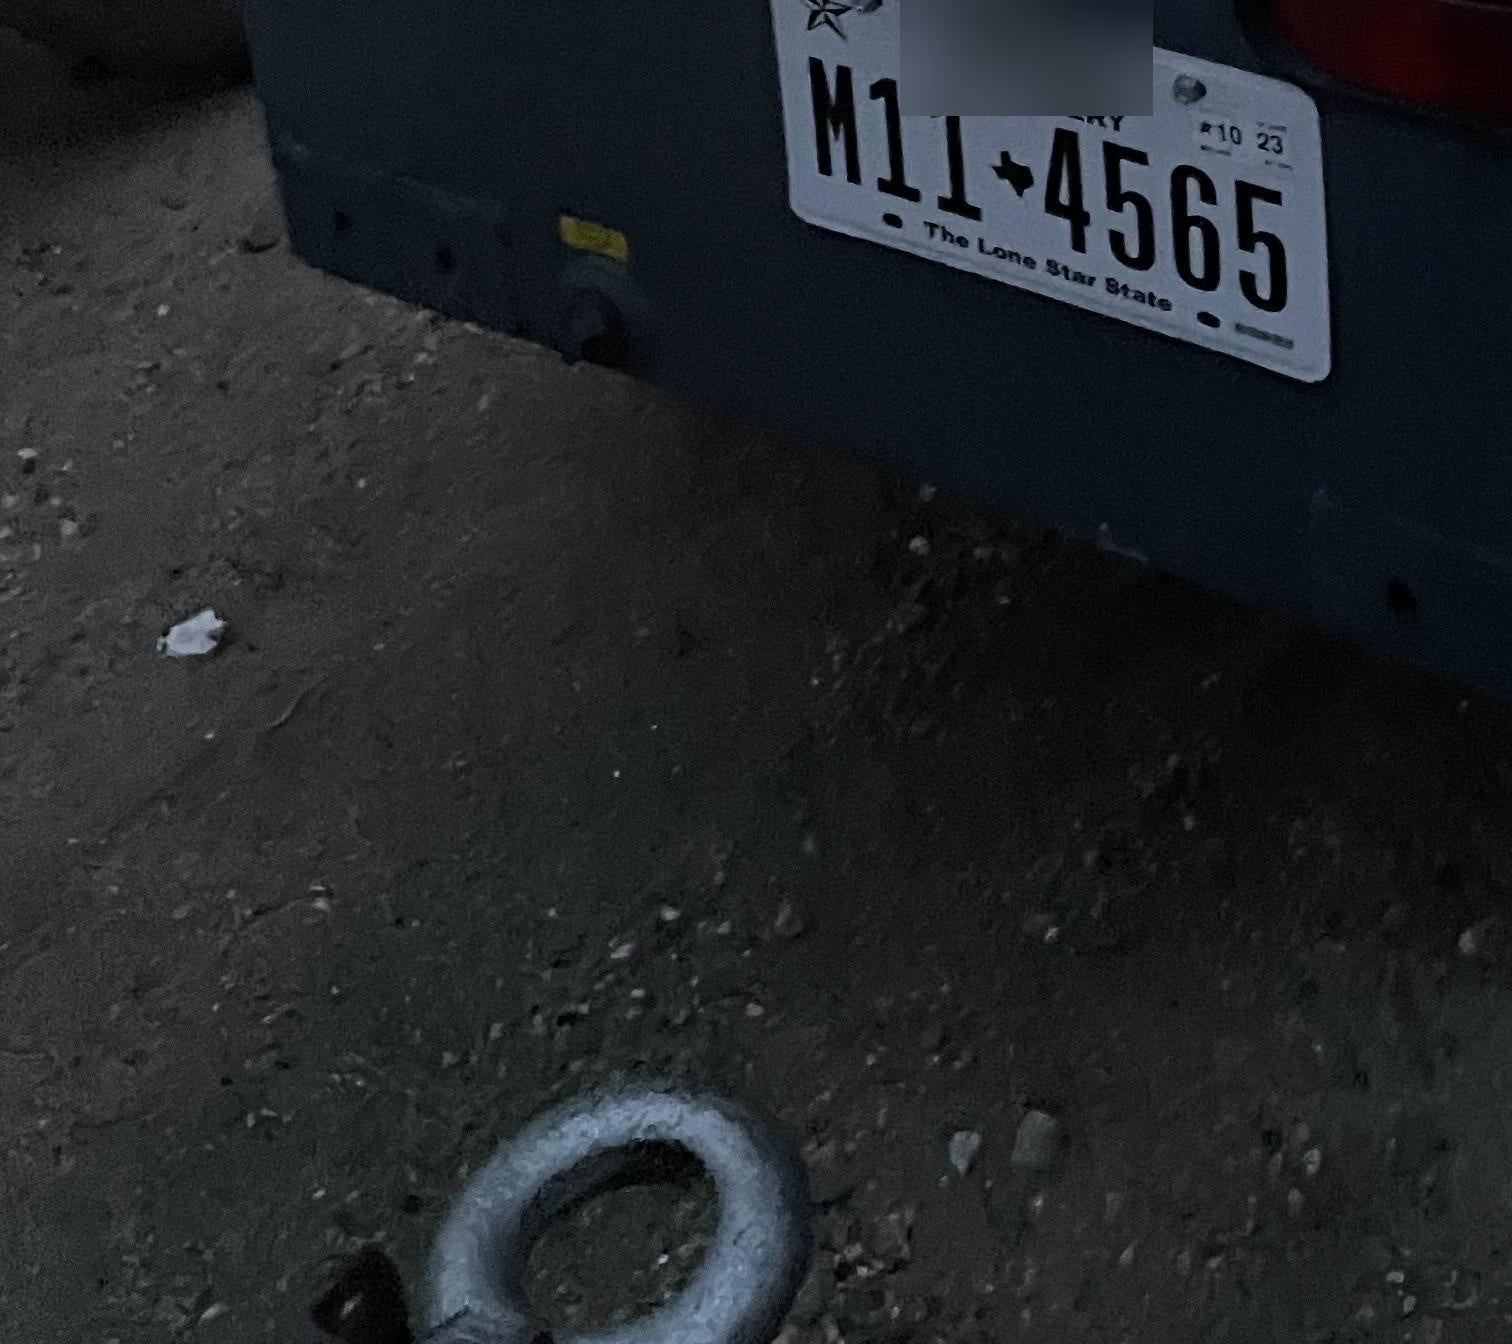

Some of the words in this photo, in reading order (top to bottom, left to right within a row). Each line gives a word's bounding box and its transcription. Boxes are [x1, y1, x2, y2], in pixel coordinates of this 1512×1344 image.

[1256, 132, 1284, 155] 23
[923, 220, 969, 249] The
[977, 236, 1038, 271] Lone
[1045, 258, 1097, 288] Star
[1105, 276, 1173, 312] State
